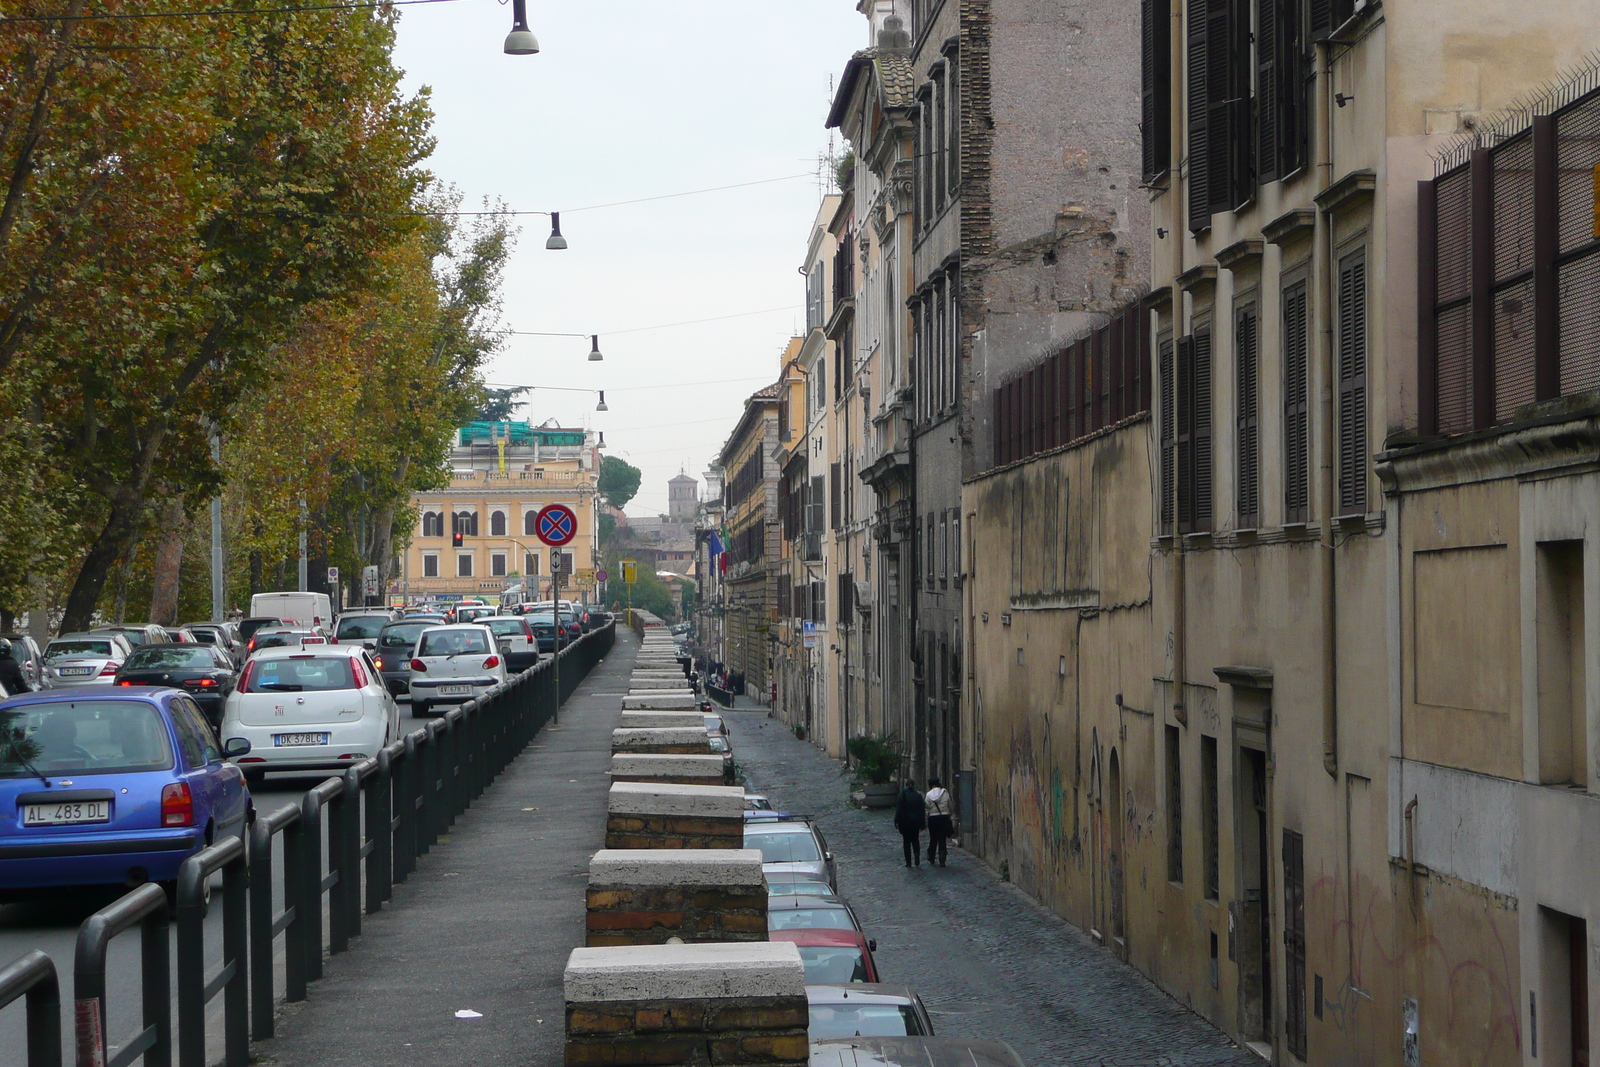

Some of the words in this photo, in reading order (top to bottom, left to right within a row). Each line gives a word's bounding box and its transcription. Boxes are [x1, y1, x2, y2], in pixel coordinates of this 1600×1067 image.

[280, 735, 292, 744] DK
[294, 734, 322, 743] 378LC
[28, 806, 45, 821] AL
[54, 804, 82, 819] 483
[87, 803, 106, 818] DL
